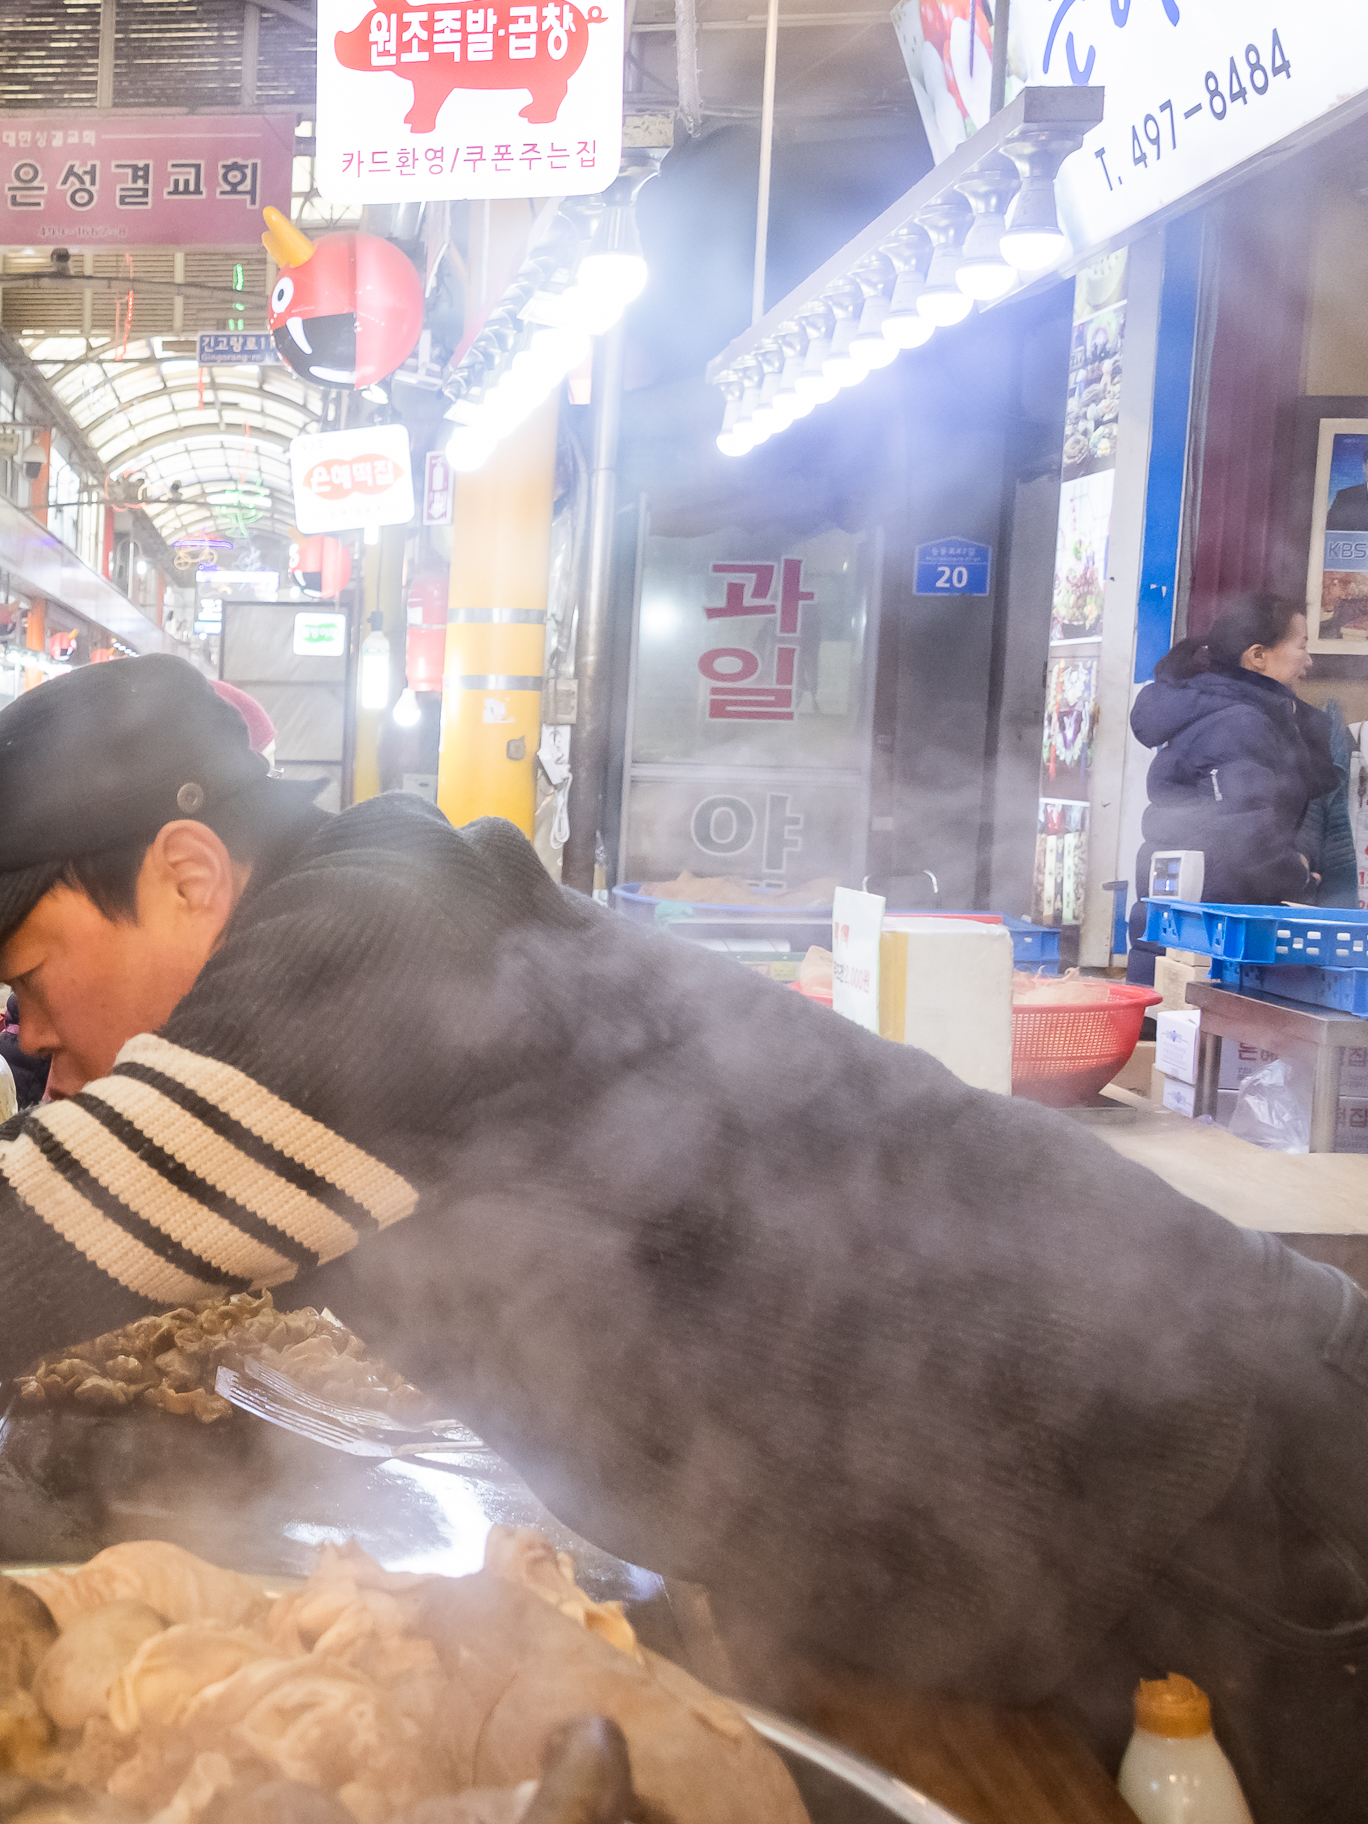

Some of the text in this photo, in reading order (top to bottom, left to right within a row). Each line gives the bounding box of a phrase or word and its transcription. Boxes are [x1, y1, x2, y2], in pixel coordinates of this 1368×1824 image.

[1131, 27, 1292, 169] 497-8484
[935, 566, 968, 588] 20
[1327, 542, 1367, 560] KBS
[696, 555, 816, 721] 과일
